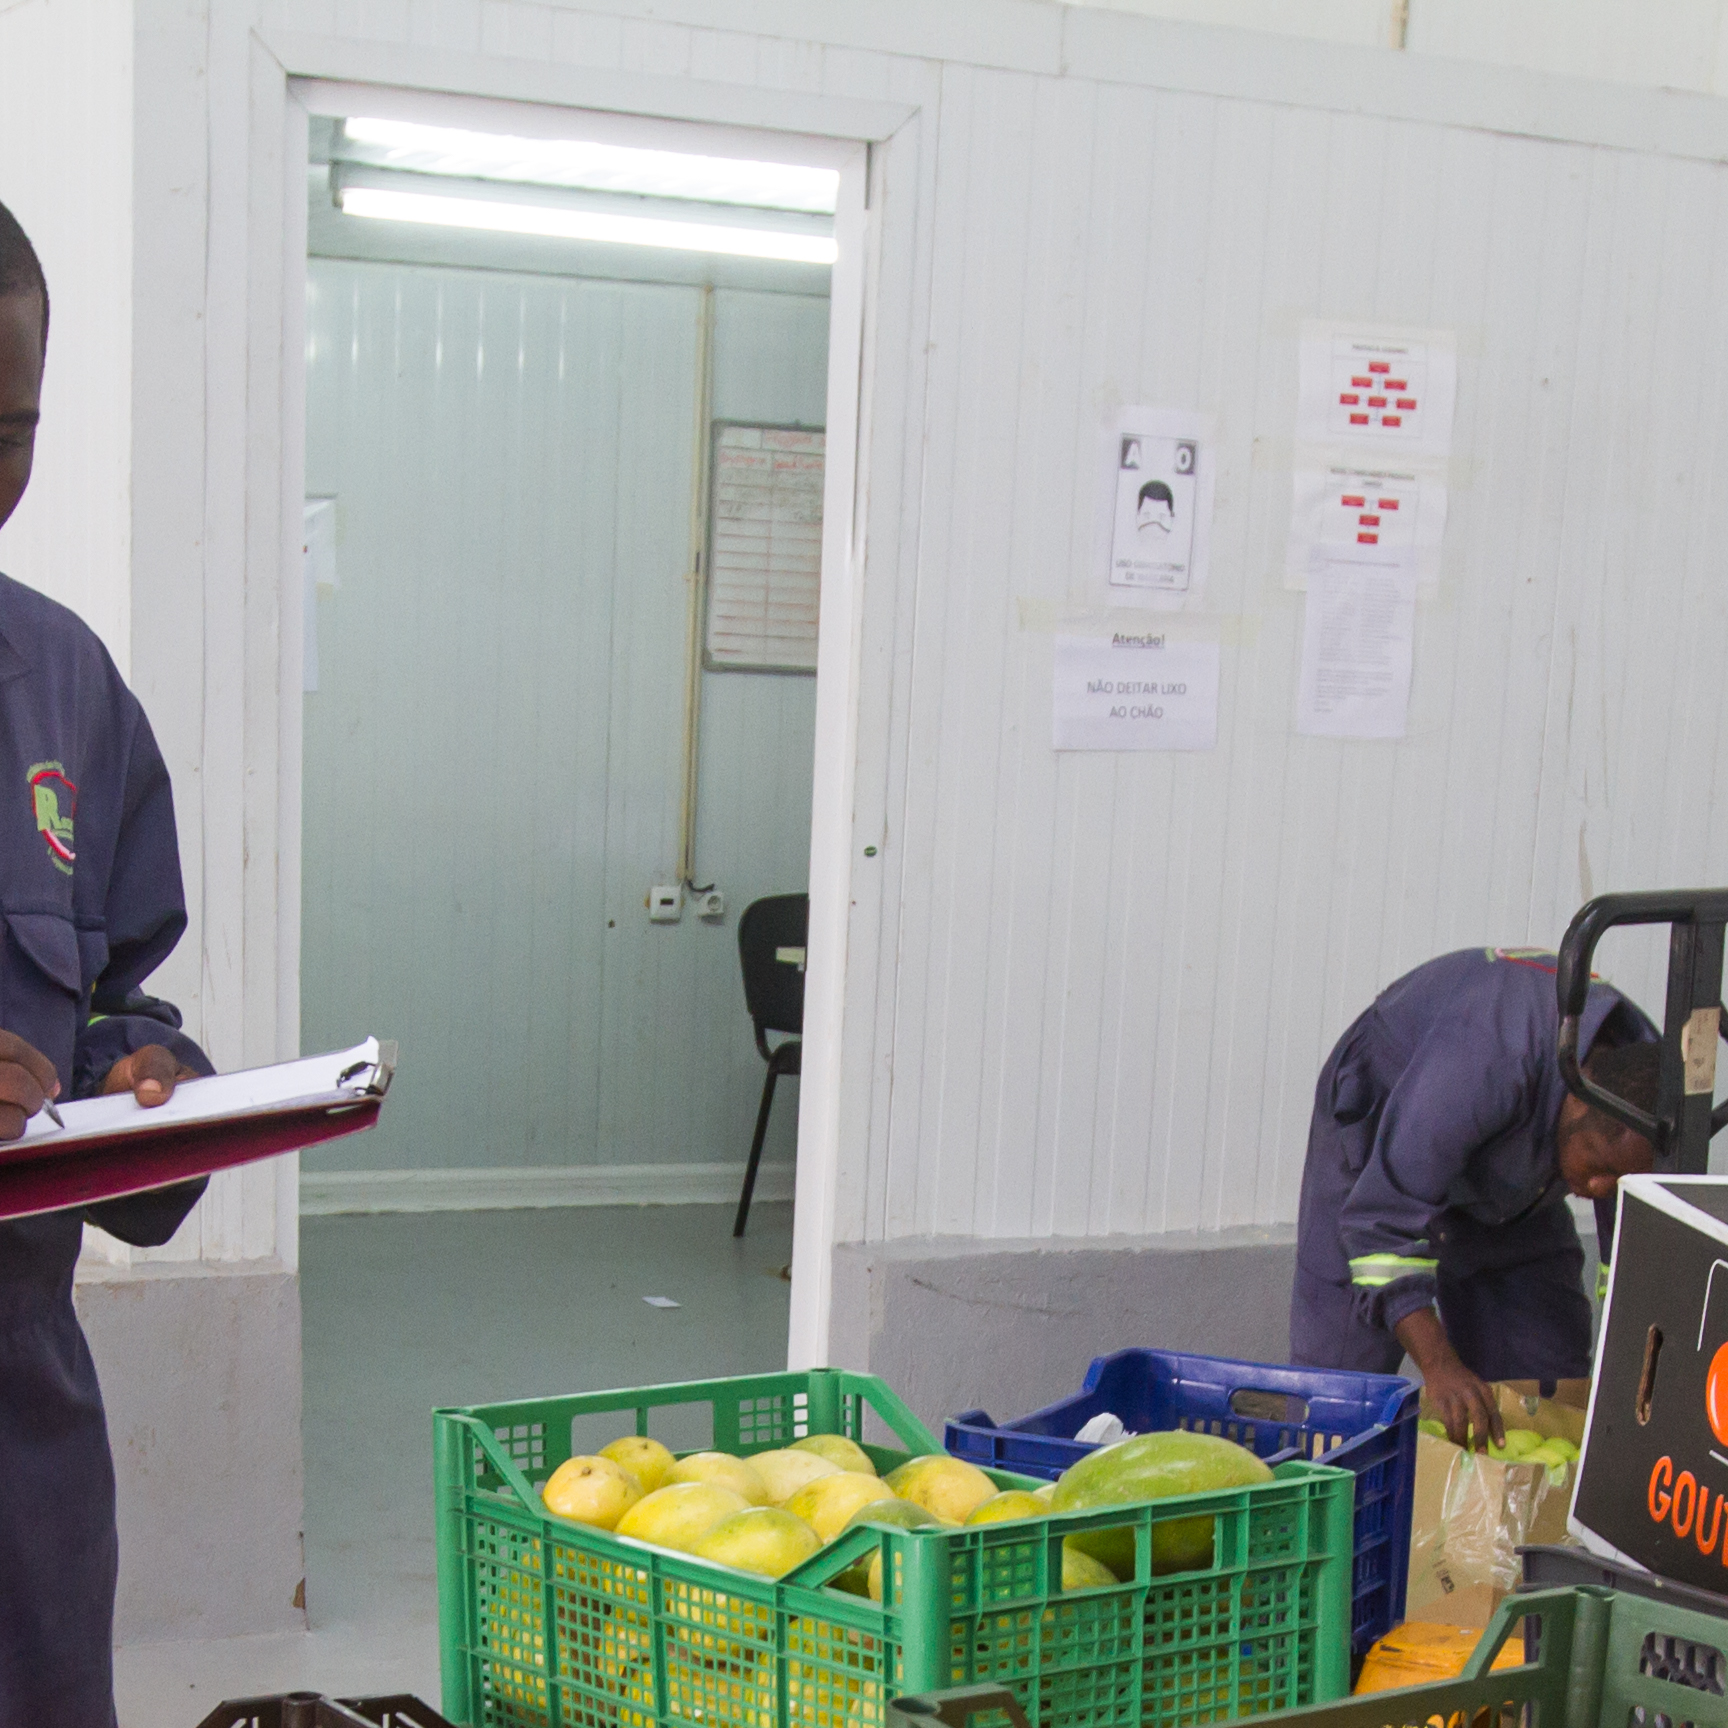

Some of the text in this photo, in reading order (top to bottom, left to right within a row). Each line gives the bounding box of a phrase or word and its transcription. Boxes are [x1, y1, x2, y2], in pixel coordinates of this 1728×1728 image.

[1112, 632, 1165, 648] Atenção!
[1087, 678, 1187, 695] NÃO DEITAR LIXO
[1109, 703, 1164, 719] AO CHÃO
